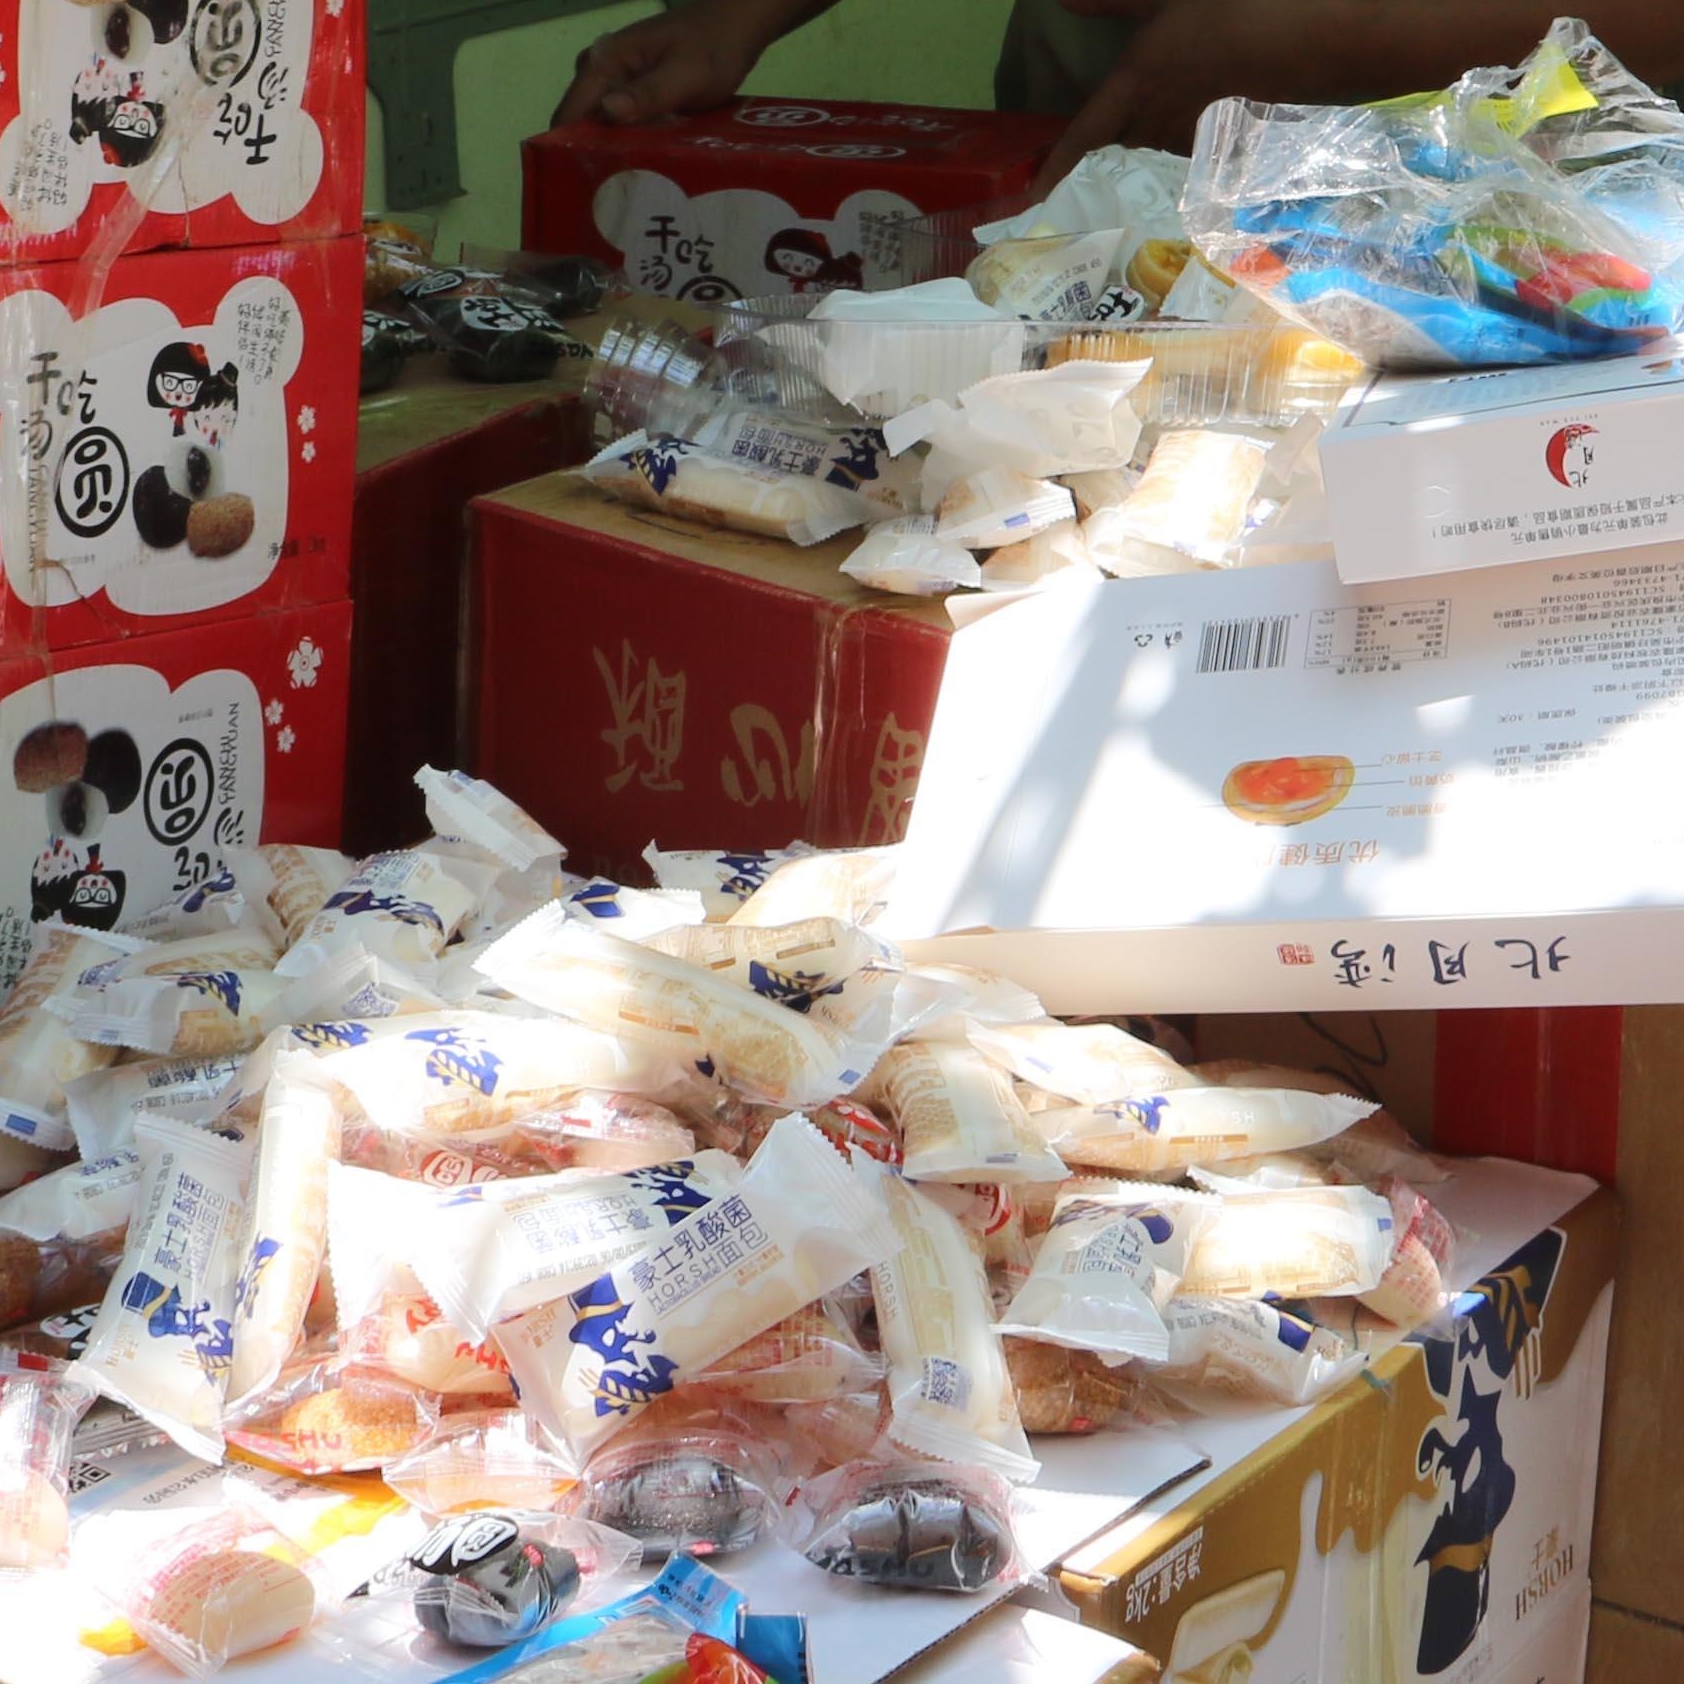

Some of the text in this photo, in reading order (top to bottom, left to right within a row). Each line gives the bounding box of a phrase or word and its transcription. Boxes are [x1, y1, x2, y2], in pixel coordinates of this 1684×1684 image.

[1510, 511, 1668, 545] 此包装单元为最小销售单元
[1330, 935, 1570, 989] 北月湾
[628, 1194, 753, 1293] 豪士乳酸菌
[1514, 1544, 1575, 1622] HORSH
